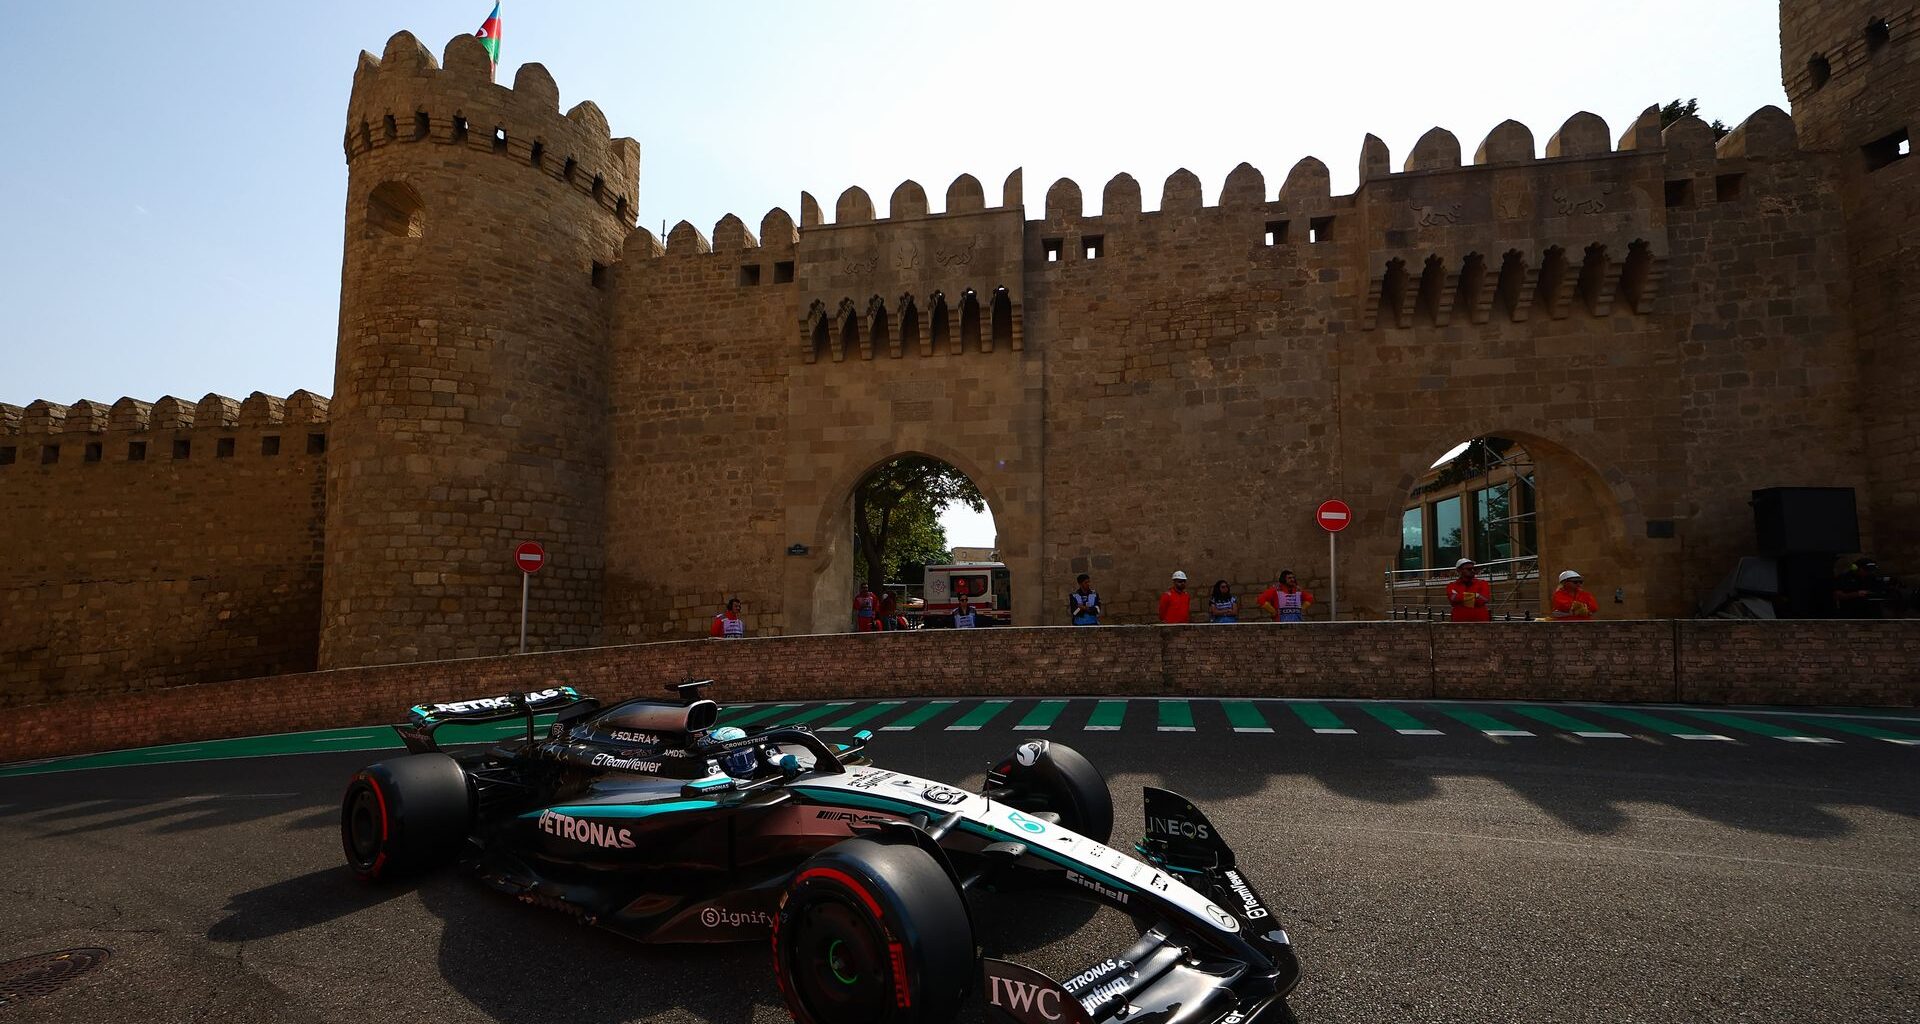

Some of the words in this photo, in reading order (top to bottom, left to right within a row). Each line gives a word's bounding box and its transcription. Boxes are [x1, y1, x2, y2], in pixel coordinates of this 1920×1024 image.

[434, 688, 559, 713] PETROAS
[616, 731, 652, 745] SOLERA
[725, 735, 769, 750] CROWDSTRIKE
[602, 753, 662, 773] TeamViewer
[662, 748, 680, 759] AMD
[701, 784, 729, 793] PETRONAS
[538, 808, 637, 849] PETRONAS
[1149, 816, 1209, 840] INEOS
[1065, 869, 1129, 905] Einhell
[1224, 869, 1260, 911] TeamViewer
[989, 975, 1062, 1021] IWC
[1220, 1009, 1245, 1024] er
